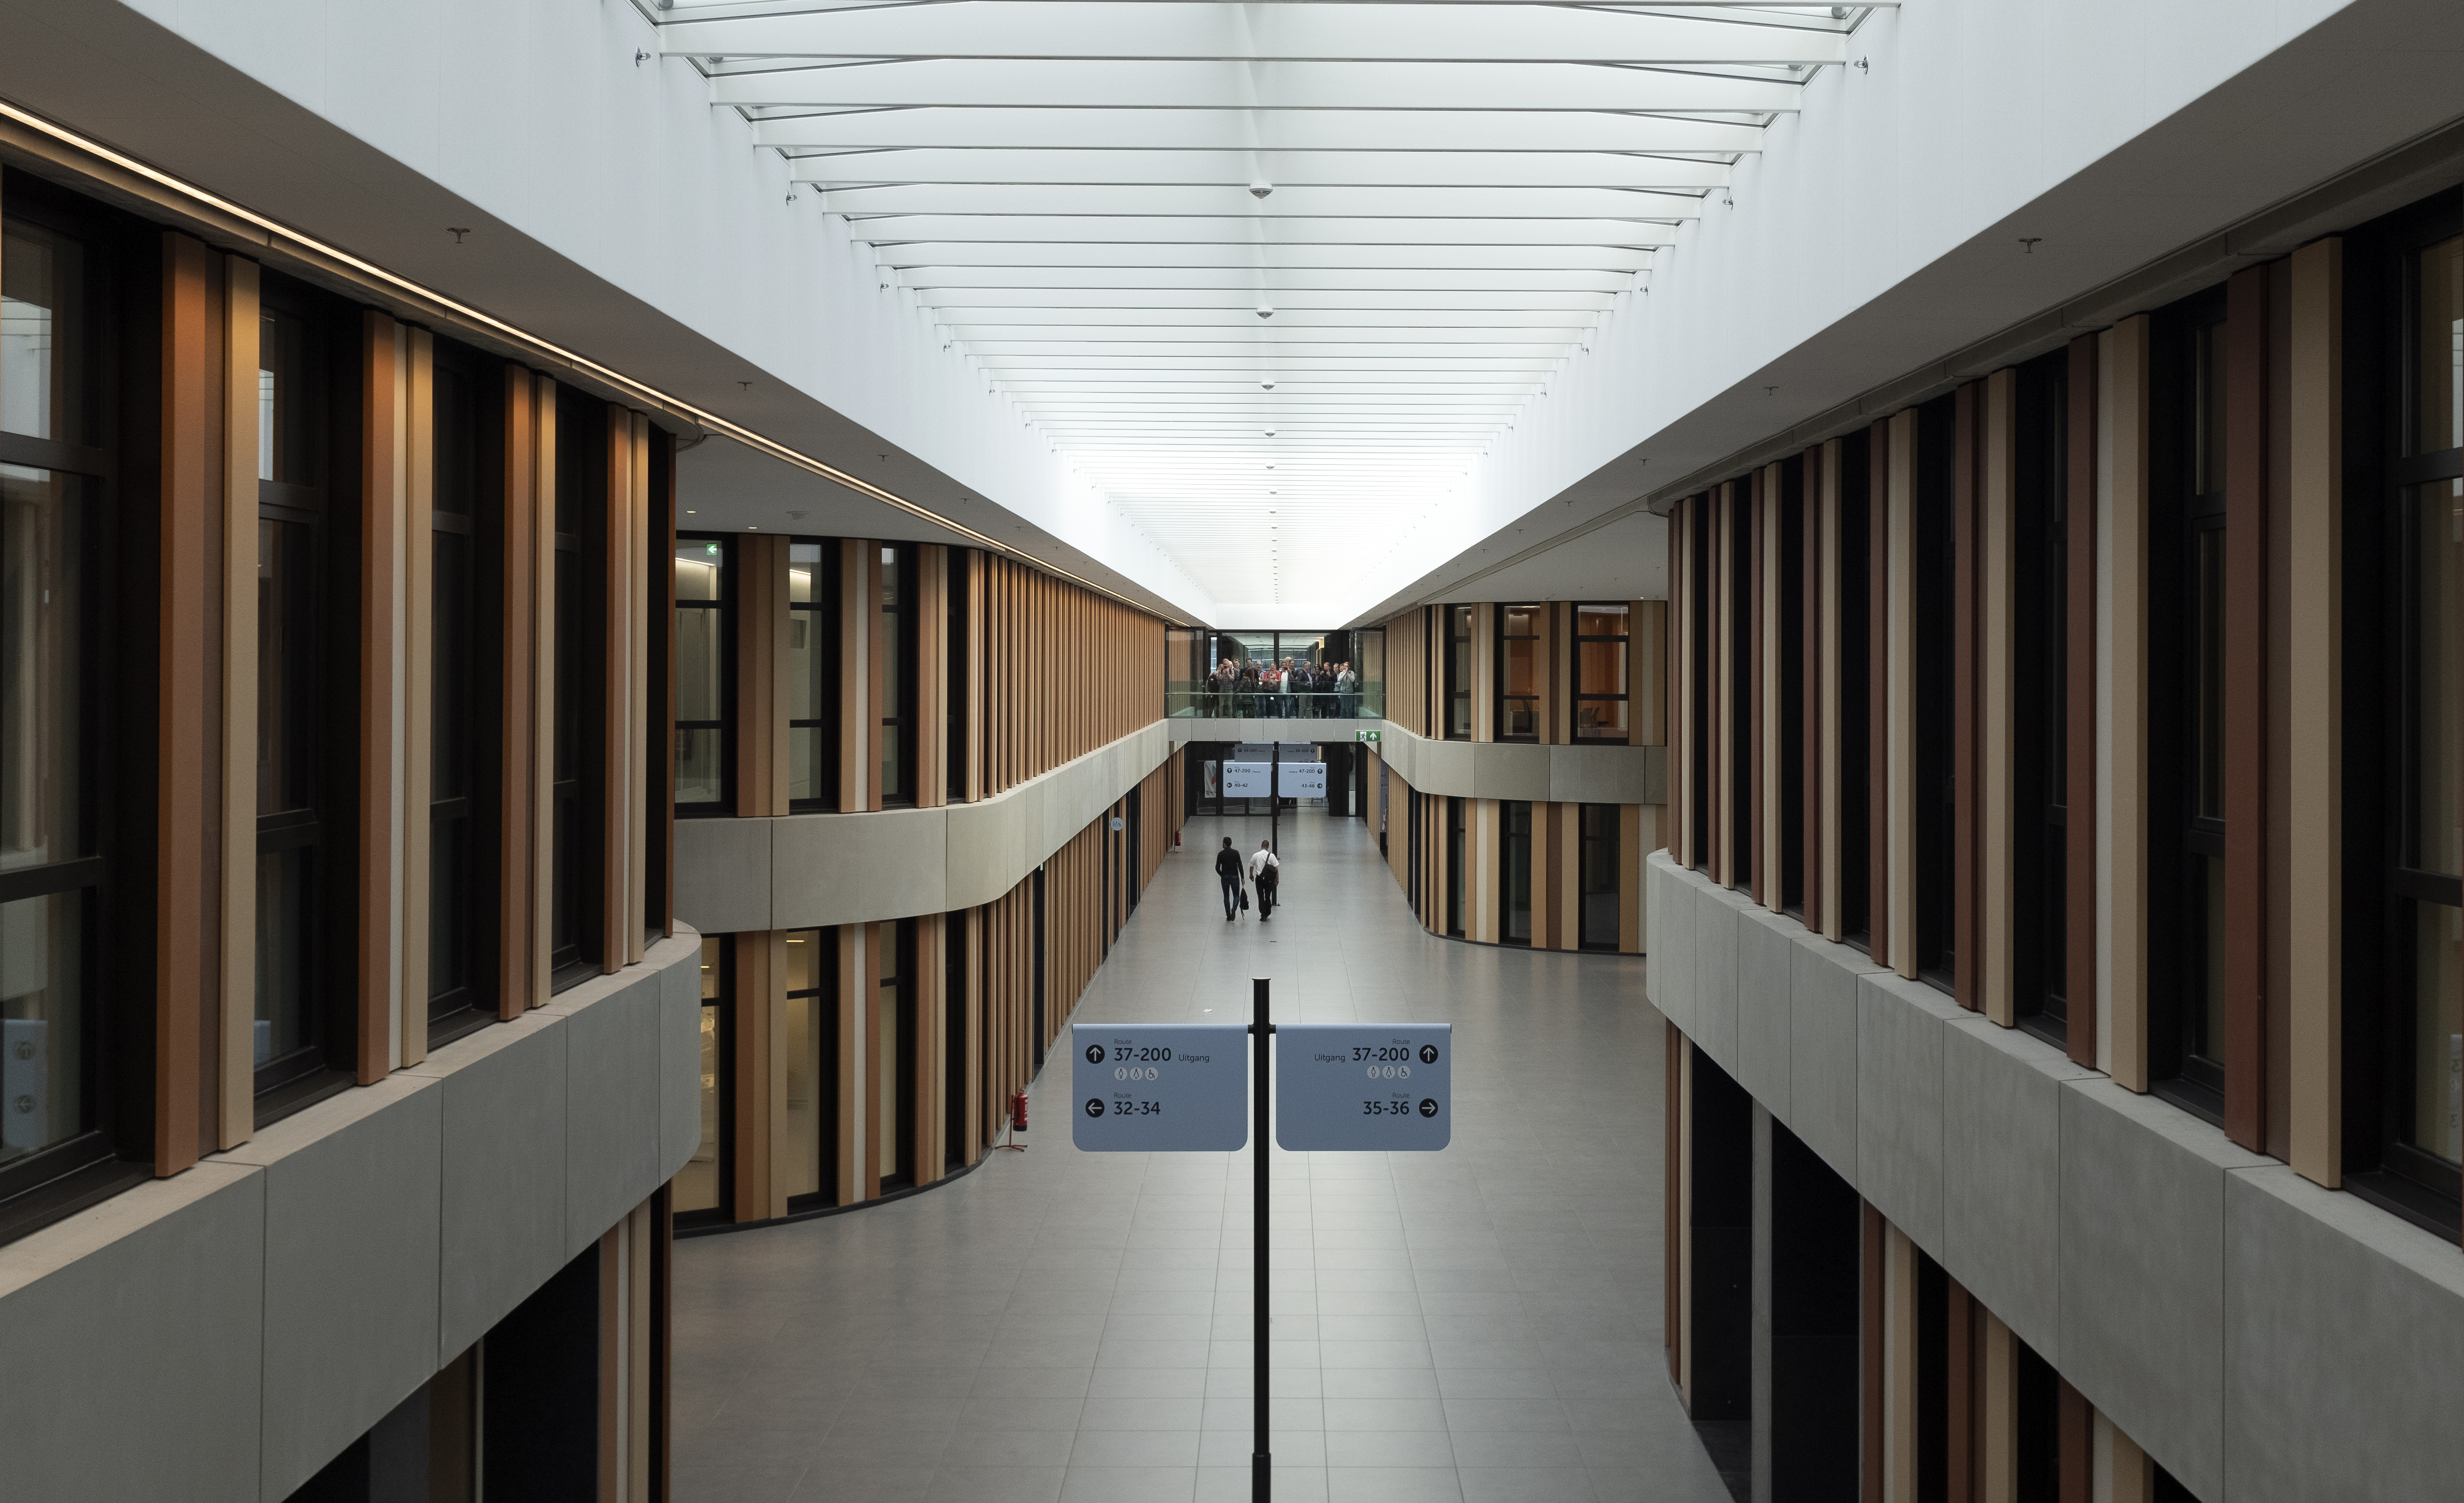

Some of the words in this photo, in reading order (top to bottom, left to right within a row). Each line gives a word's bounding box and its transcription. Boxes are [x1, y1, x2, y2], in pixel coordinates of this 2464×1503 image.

[1114, 1047, 1172, 1061] 37-200
[1178, 1054, 1210, 1063] Uitgang
[1314, 1053, 1346, 1063] Uitgang
[1352, 1047, 1410, 1061] 37-200
[1114, 1101, 1161, 1115] 32-34
[1363, 1101, 1410, 1115] 35-36
